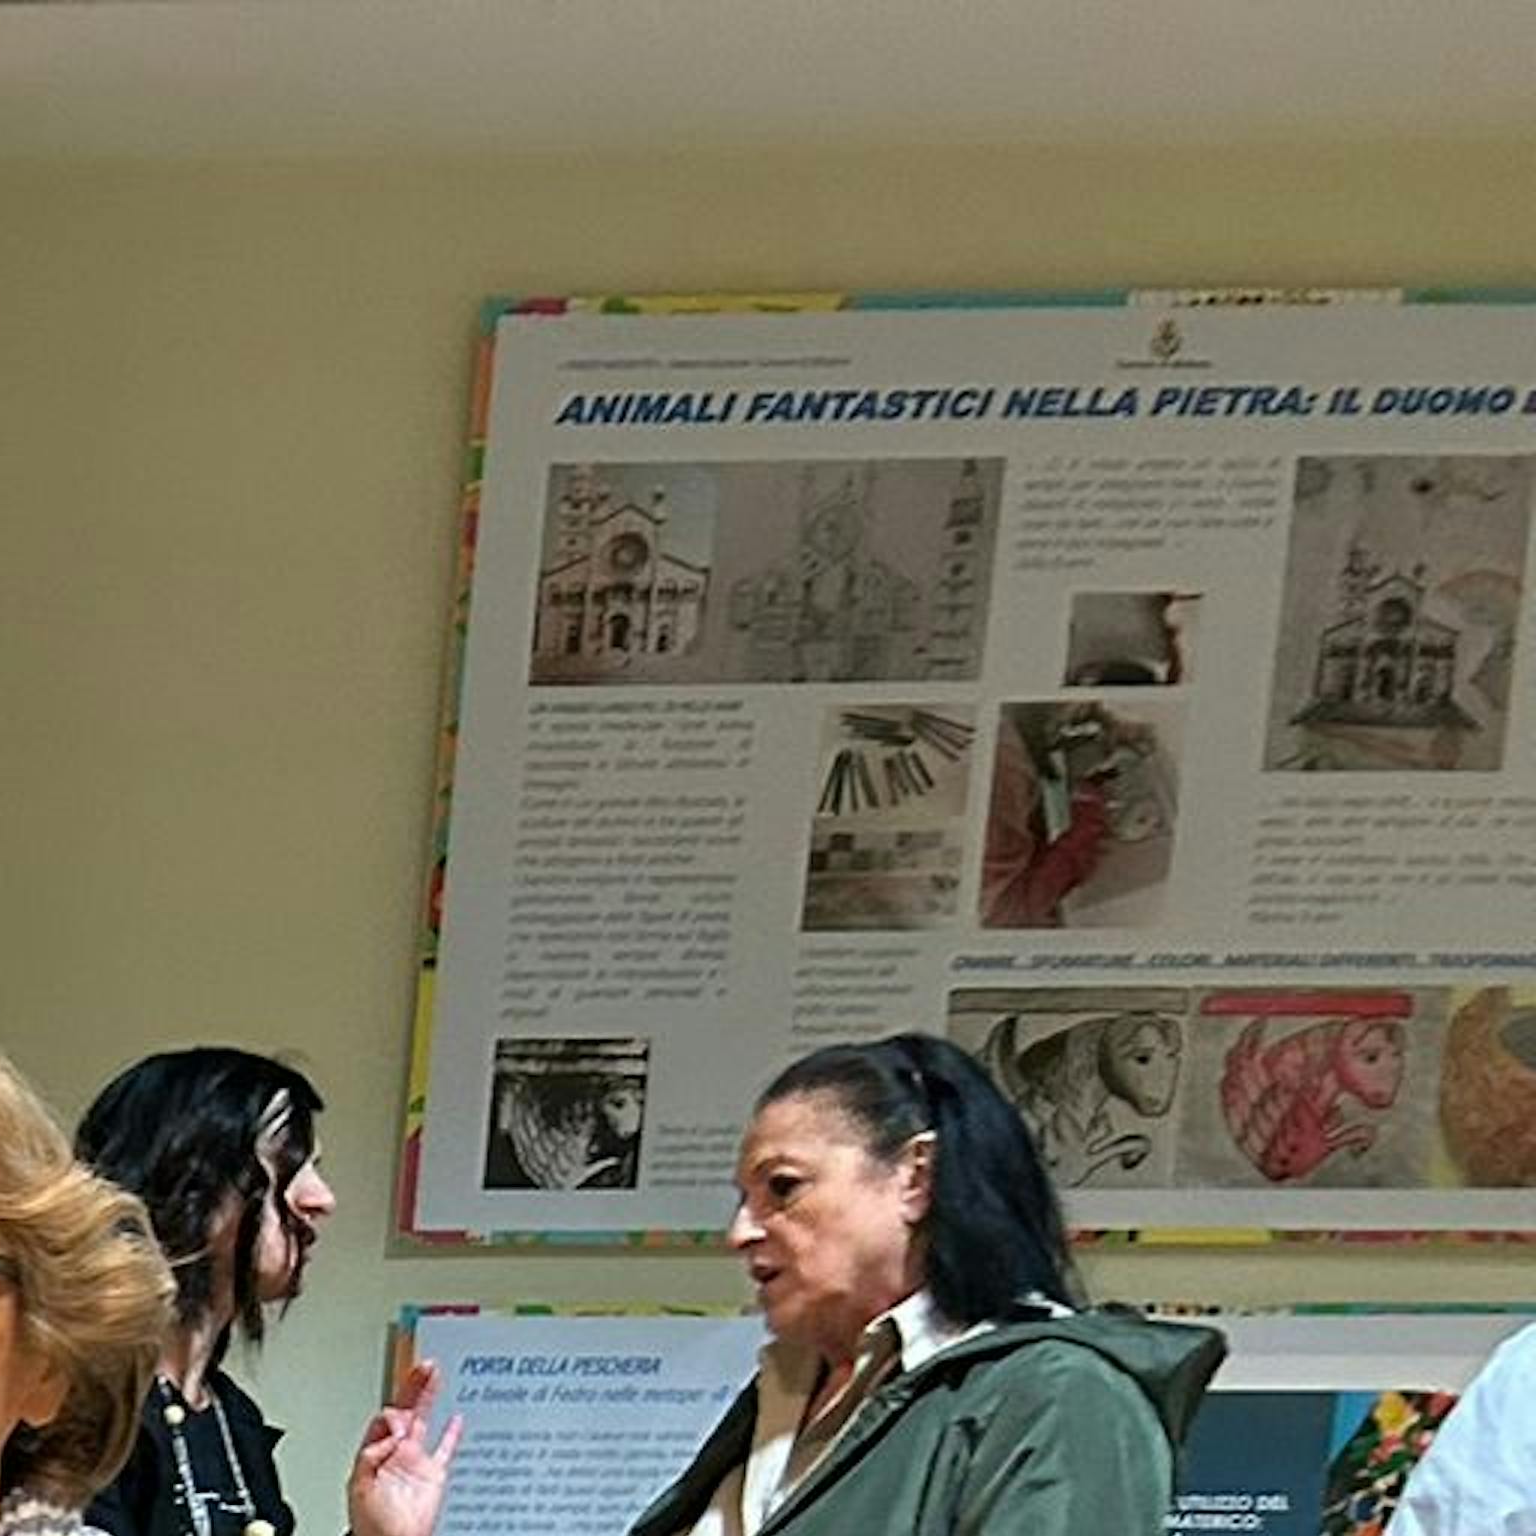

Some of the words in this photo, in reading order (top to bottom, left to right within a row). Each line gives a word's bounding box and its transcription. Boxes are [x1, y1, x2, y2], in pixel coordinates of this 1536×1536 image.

[555, 393, 739, 426] ANIMALI
[744, 387, 991, 423] FANTASTICI
[1002, 386, 1138, 418] NELLA
[1149, 385, 1317, 416] PIETRA:
[1326, 386, 1359, 415] IL
[1372, 386, 1516, 414] DUOMO
[458, 1356, 513, 1375] PORTA
[516, 1356, 569, 1375] DELLA
[1255, 1494, 1290, 1511] DEL
